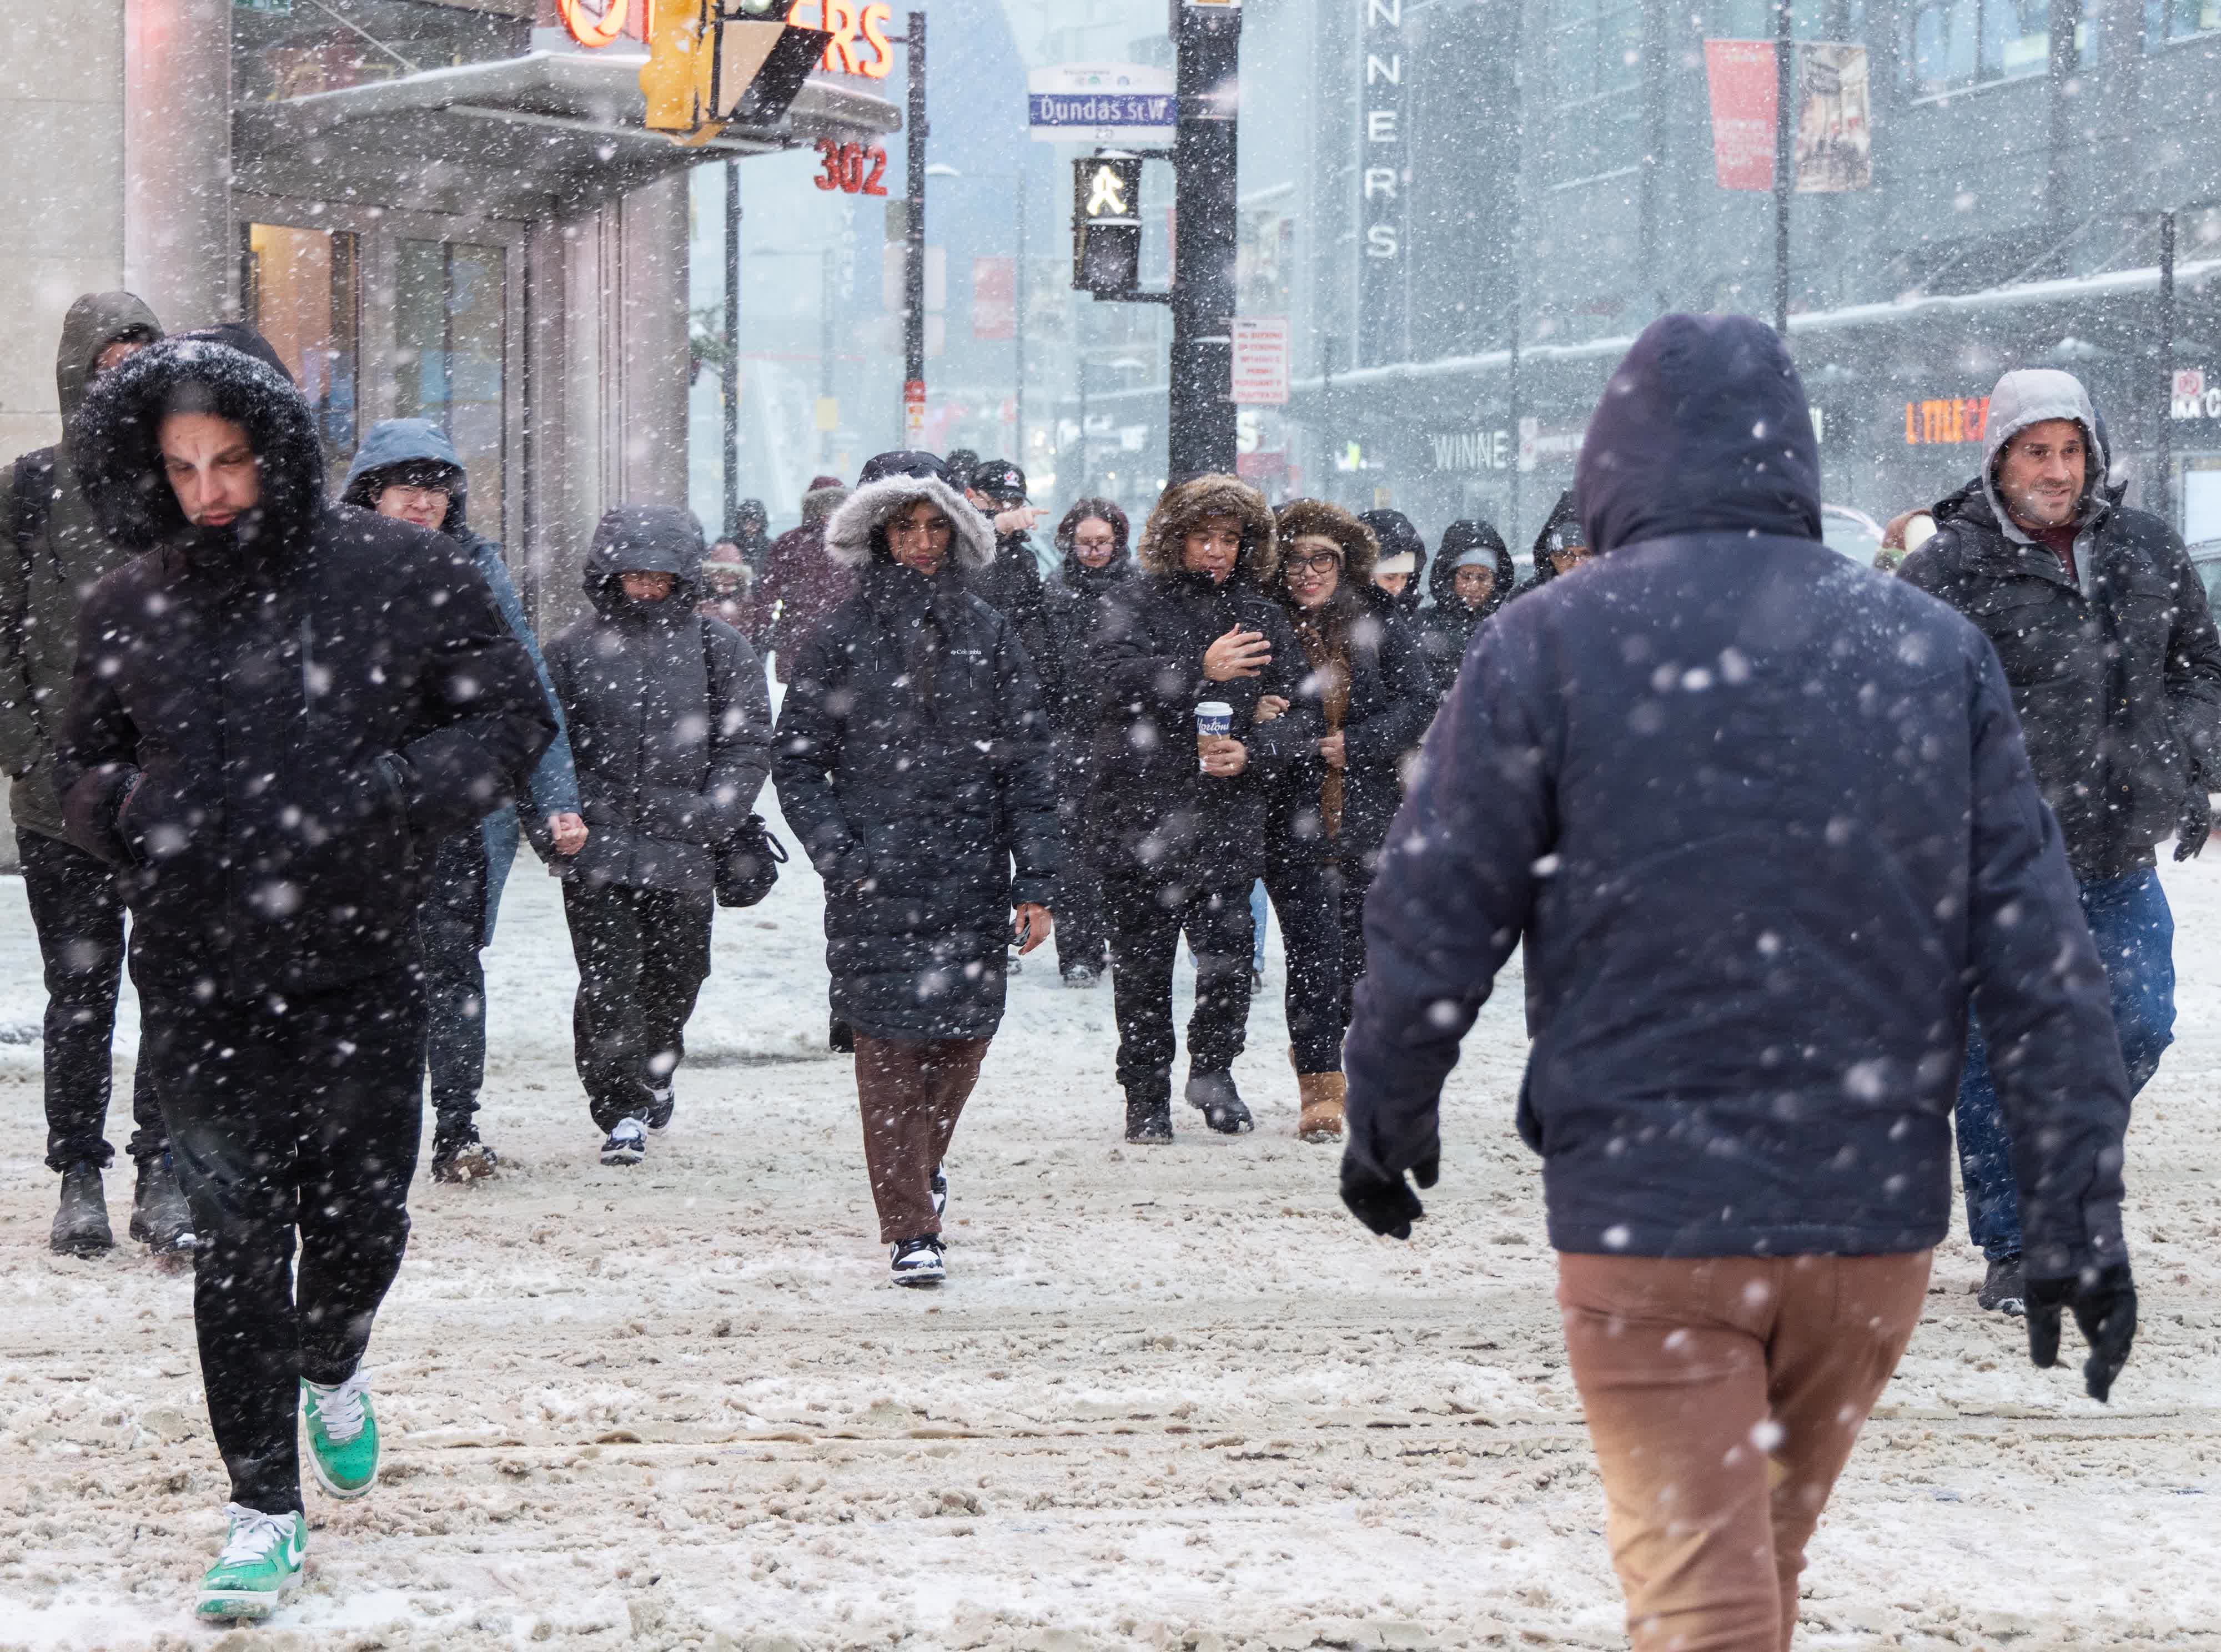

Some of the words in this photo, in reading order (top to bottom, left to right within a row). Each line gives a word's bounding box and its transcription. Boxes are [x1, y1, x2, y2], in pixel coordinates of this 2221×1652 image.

[1040, 97, 1122, 121] Dundas
[1127, 100, 1145, 120] St
[1147, 97, 1168, 120] W
[814, 138, 888, 195] 302
[1434, 430, 1509, 471] WINNE
